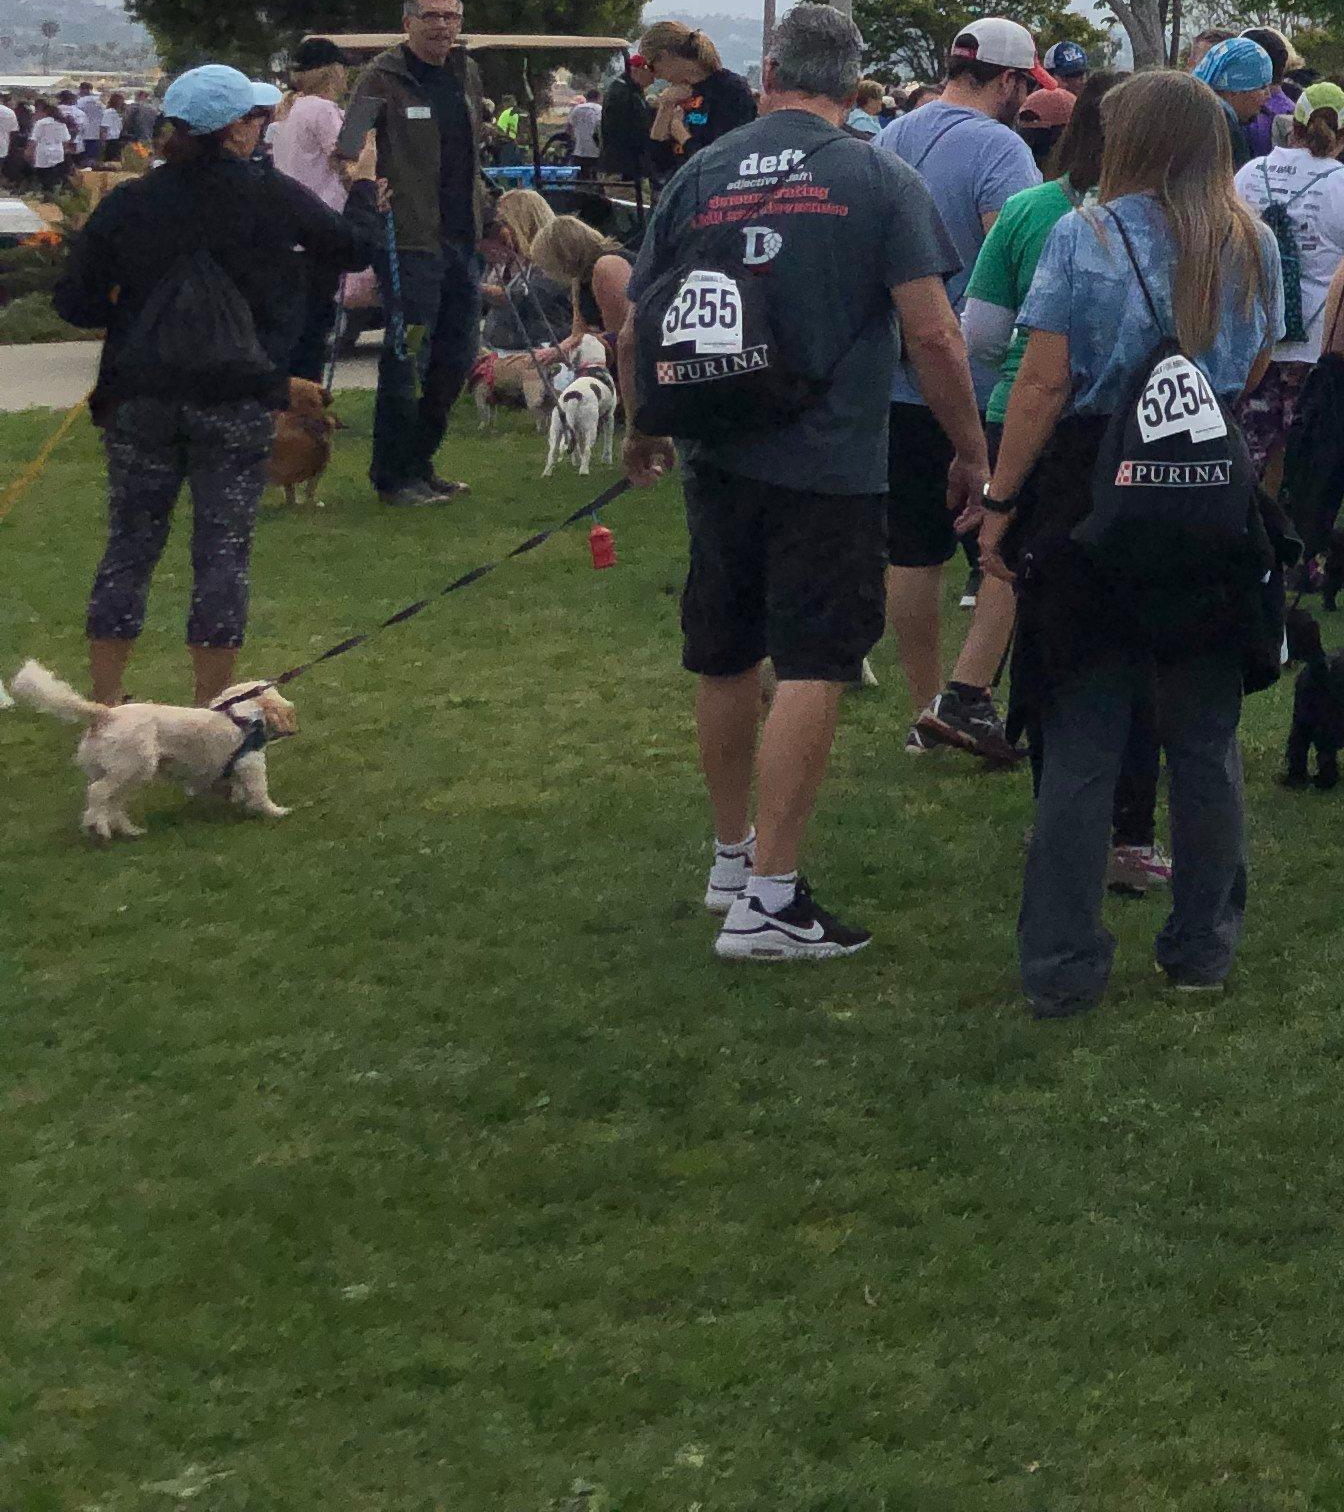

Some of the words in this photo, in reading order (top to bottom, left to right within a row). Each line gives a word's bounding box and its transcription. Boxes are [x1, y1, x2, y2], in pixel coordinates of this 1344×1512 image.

[739, 149, 806, 176] deft
[665, 287, 737, 333] 5255
[676, 350, 762, 380] PURINA
[1142, 371, 1215, 428] 5254
[1134, 464, 1225, 483] PURINA
